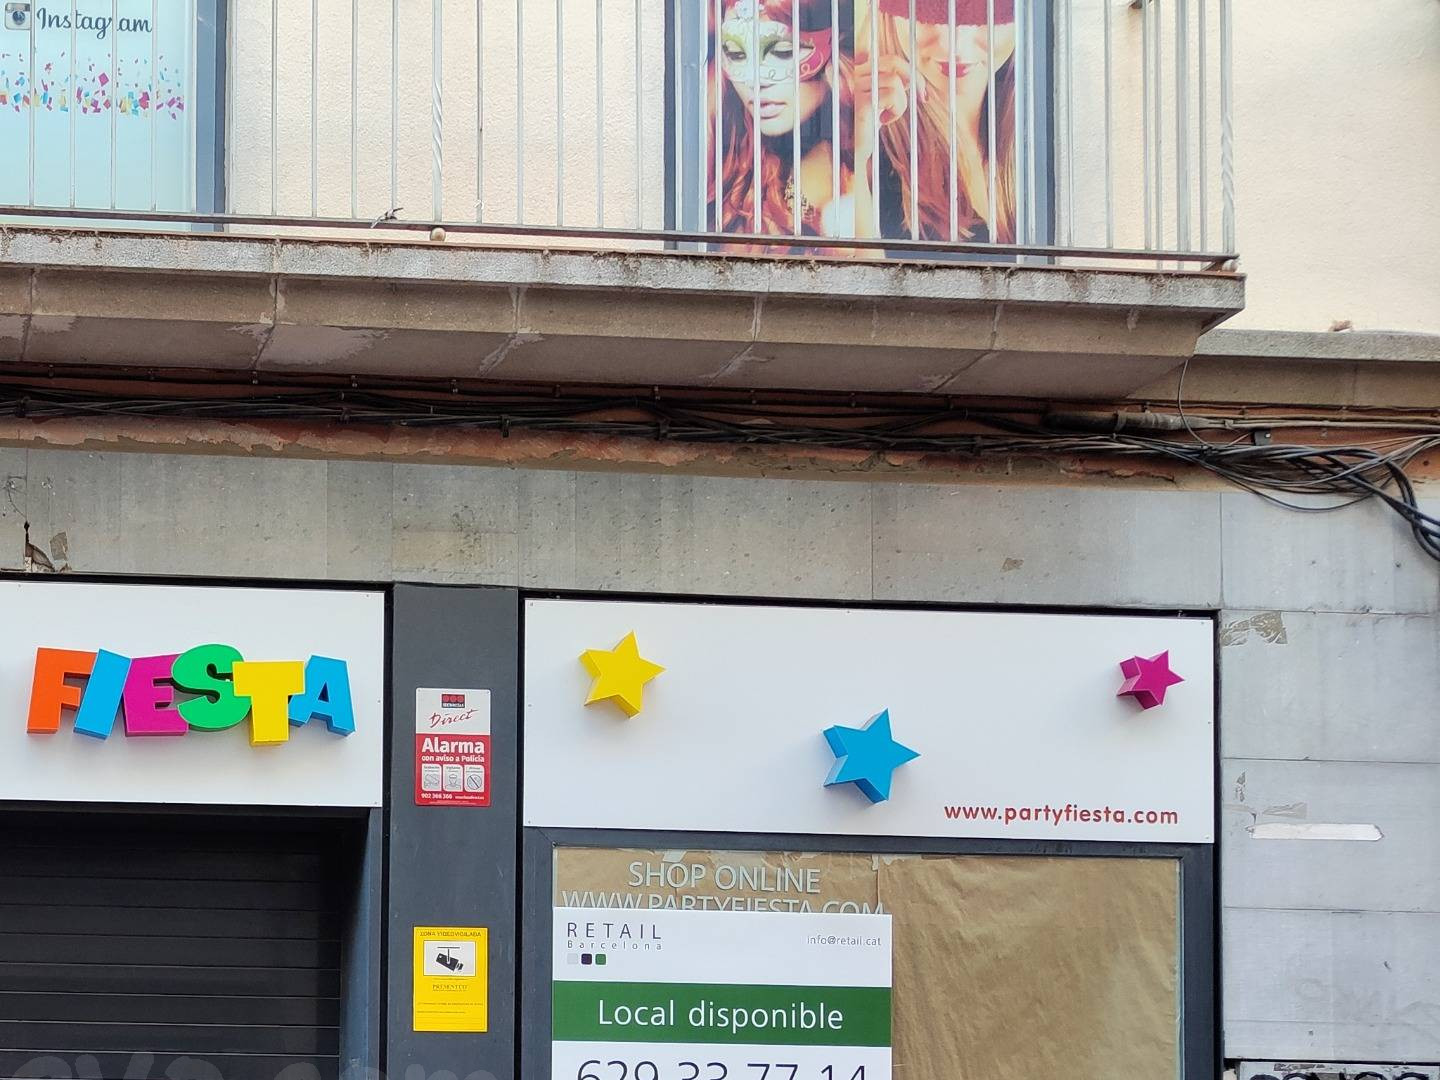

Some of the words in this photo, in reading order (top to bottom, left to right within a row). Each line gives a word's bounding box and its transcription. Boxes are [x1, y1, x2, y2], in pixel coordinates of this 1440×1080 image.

[26, 643, 356, 746] FIESTA
[429, 709, 479, 728] Direct
[421, 737, 485, 754] Alarma
[435, 754, 454, 762] aviso
[944, 804, 1178, 826] www.partyfiesta.com
[628, 861, 706, 888] SHOP
[714, 865, 821, 893] ONLINE
[567, 922, 662, 940] RETAIL
[806, 935, 882, 947] info@retail.cat
[567, 940, 662, 951] Barcelona
[599, 999, 674, 1026] Local
[688, 1000, 843, 1034] disponible
